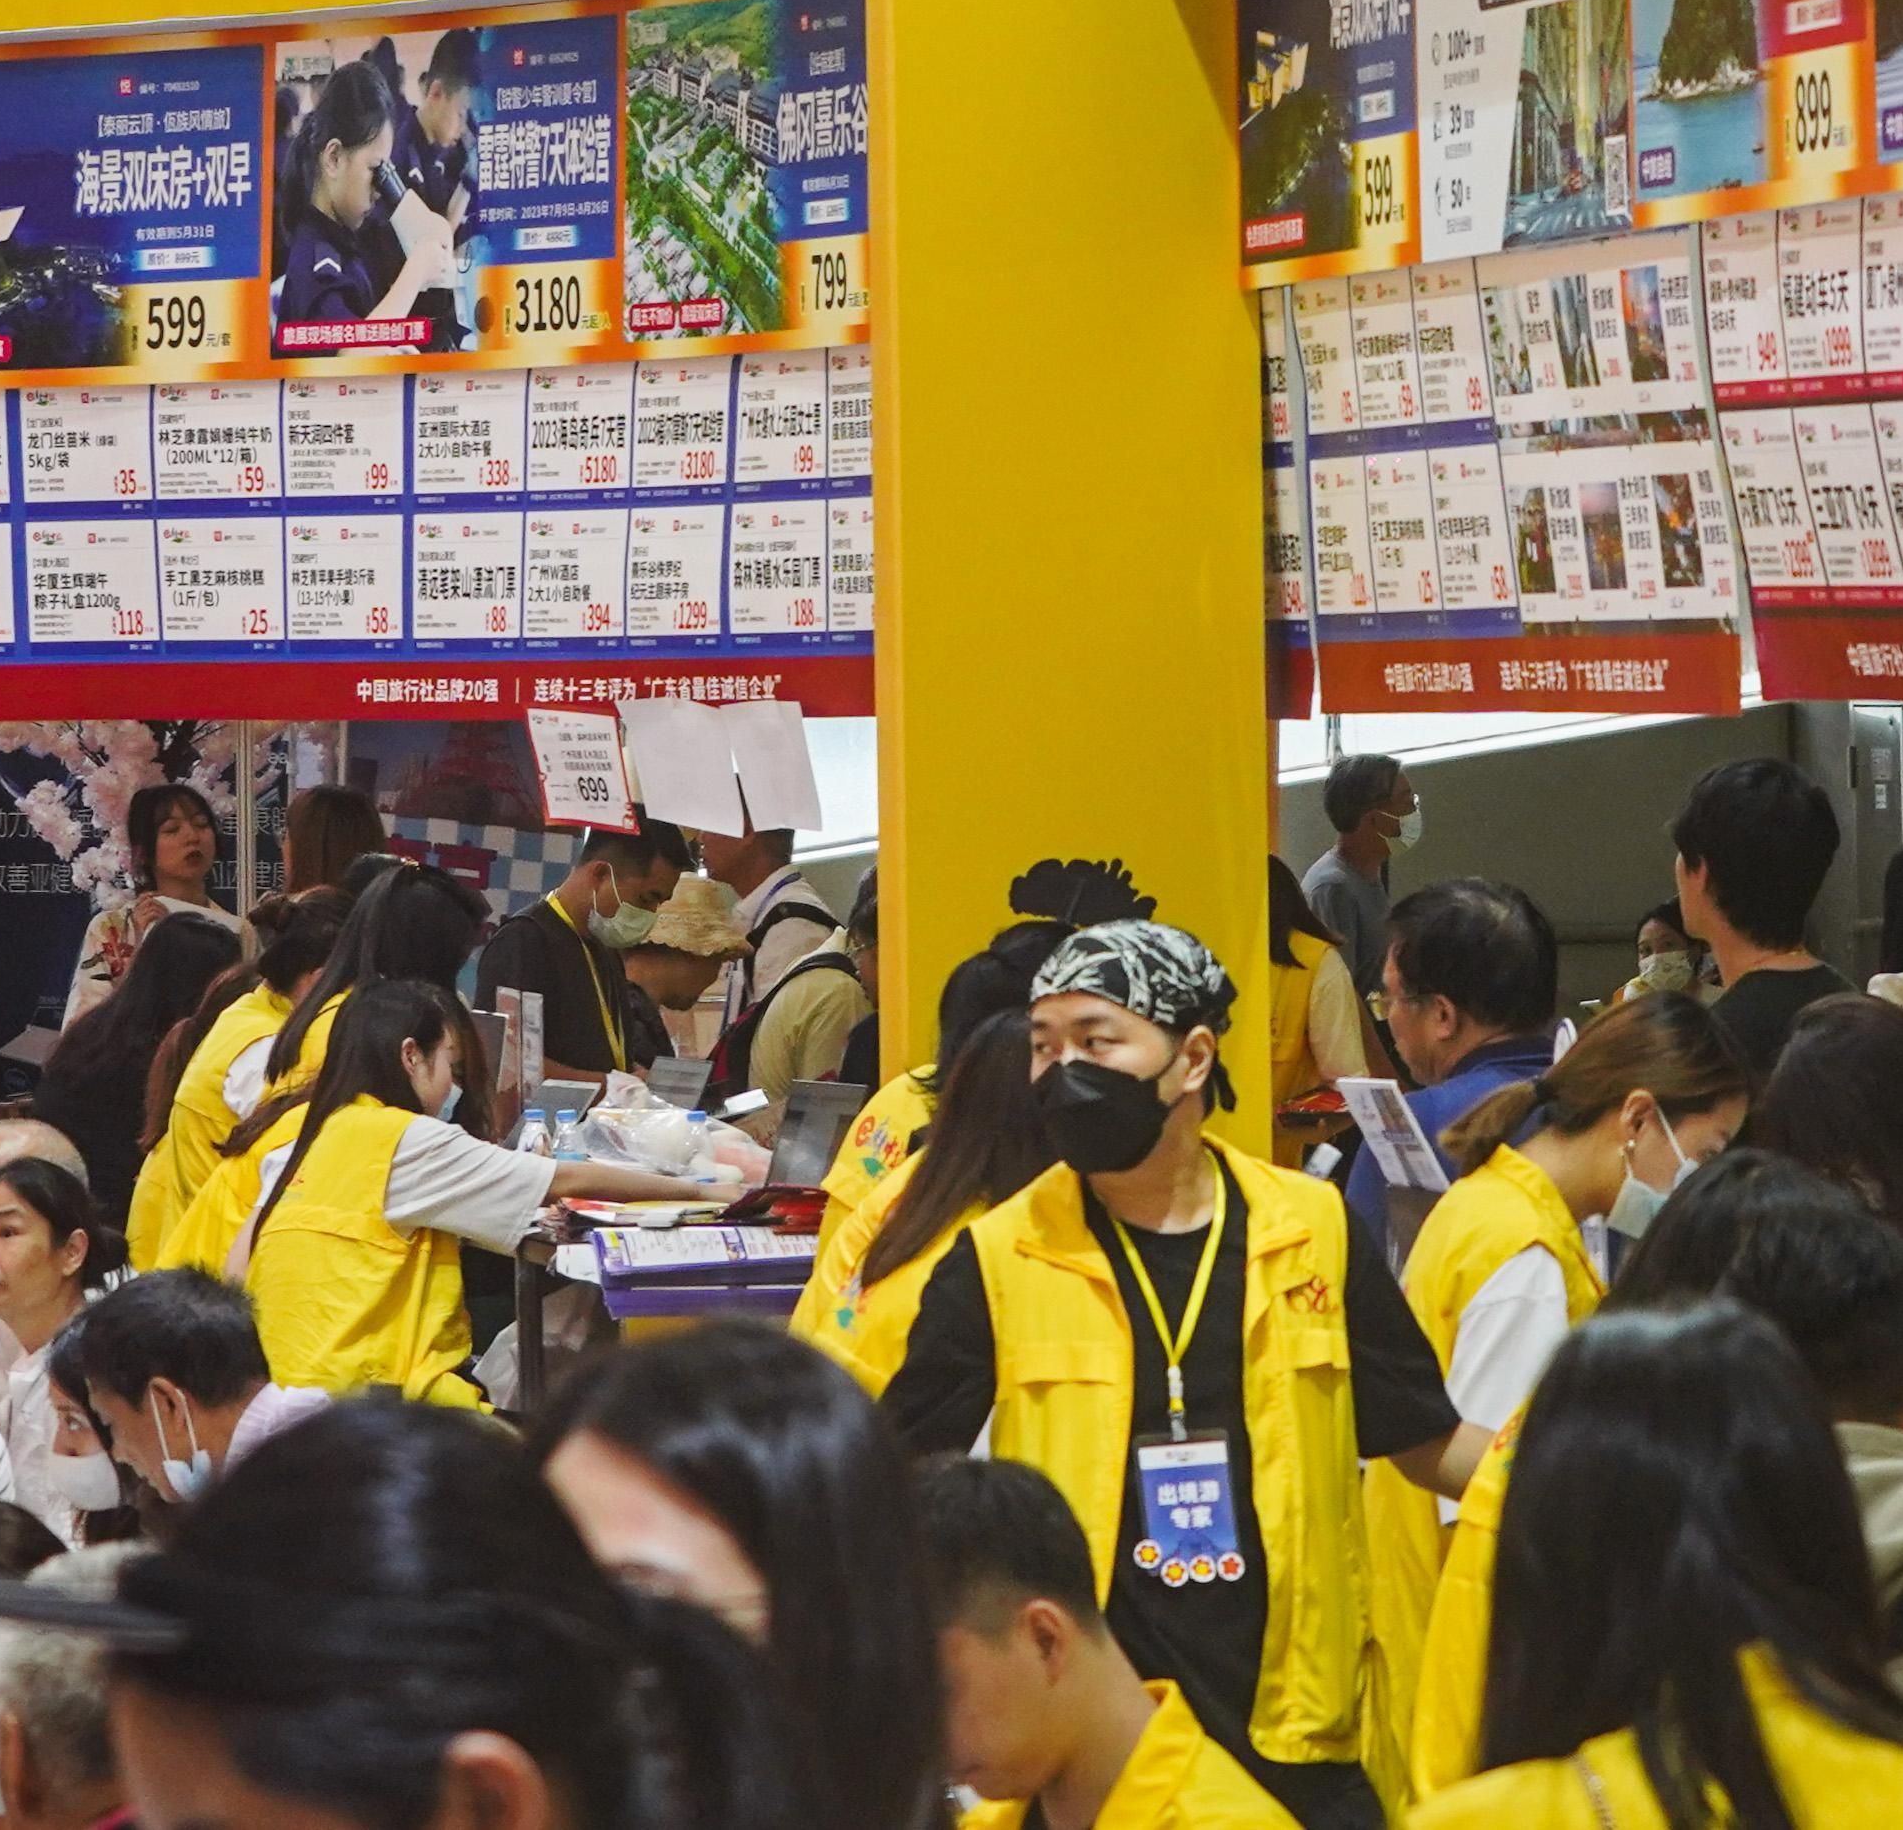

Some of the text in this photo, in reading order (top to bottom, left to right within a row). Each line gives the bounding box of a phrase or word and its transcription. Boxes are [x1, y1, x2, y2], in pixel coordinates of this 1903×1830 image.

[1795, 68, 1832, 155] 899
[74, 141, 253, 217] 海景双床房+双早
[1363, 153, 1393, 227] 599
[811, 251, 847, 311] 799
[515, 275, 582, 333] 3180
[146, 296, 206, 350] 599
[417, 420, 491, 439] 亚洲国际大酒店
[485, 459, 510, 487] 338
[584, 454, 618, 485] 5180
[685, 450, 716, 480] 3180
[798, 445, 814, 474] 99
[118, 468, 137, 495] 35
[244, 466, 265, 492] 59
[369, 463, 389, 490] 99
[118, 609, 144, 636] 118
[249, 609, 269, 635] 25
[370, 606, 389, 635] 58
[490, 606, 506, 633] 88
[586, 604, 611, 632] 394
[678, 601, 708, 630] 1299
[793, 599, 815, 626] 188
[356, 676, 500, 704] 中国旅行社品牌20强
[578, 776, 610, 803] 699
[1169, 1505, 1214, 1530] 专家
